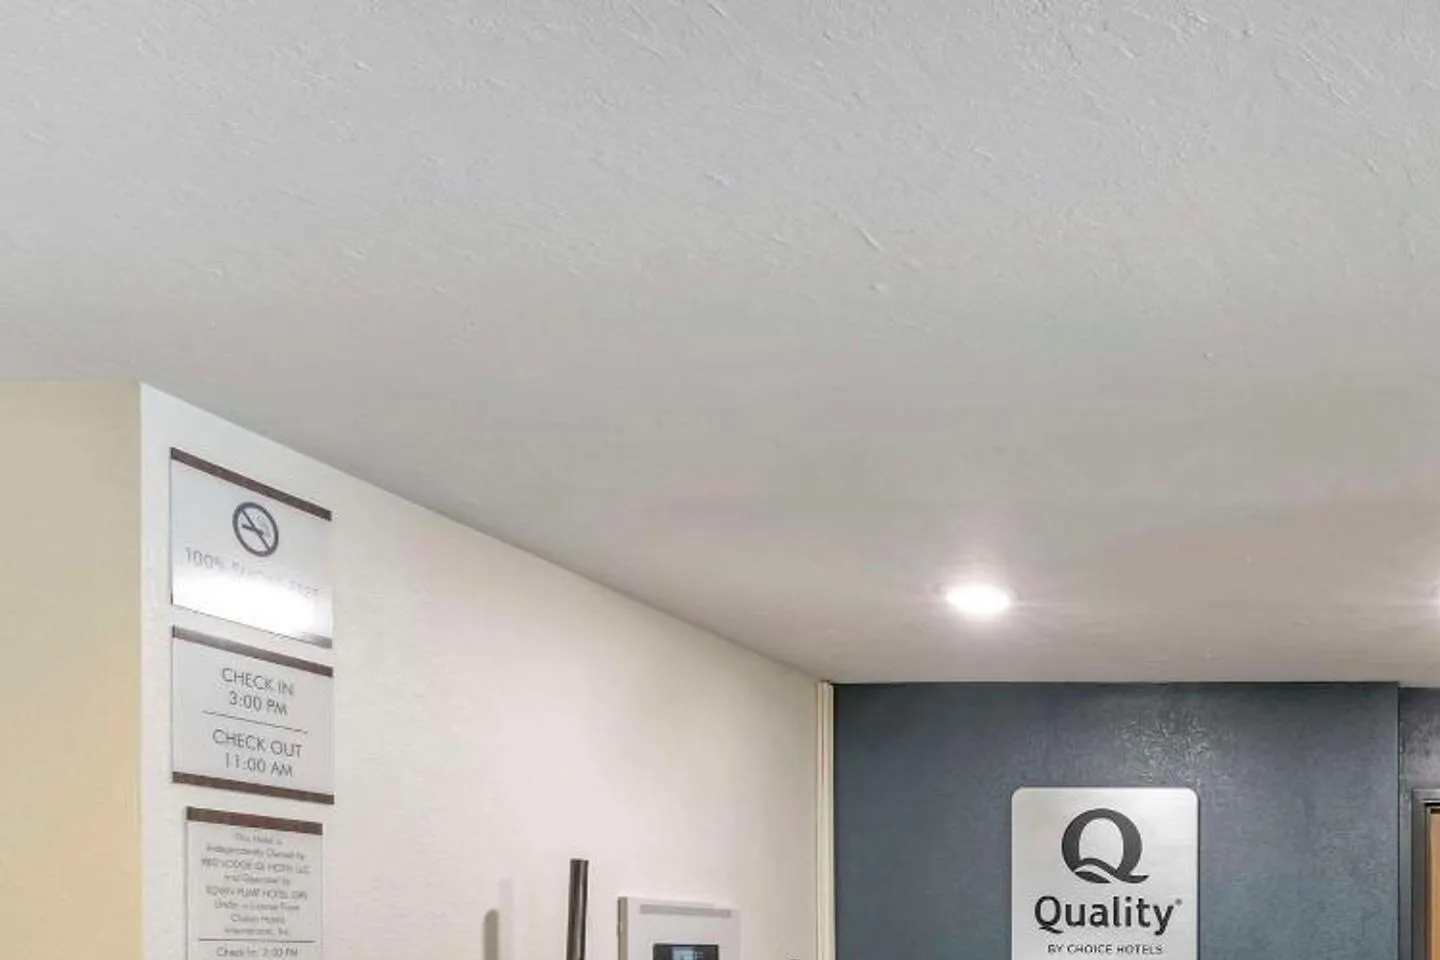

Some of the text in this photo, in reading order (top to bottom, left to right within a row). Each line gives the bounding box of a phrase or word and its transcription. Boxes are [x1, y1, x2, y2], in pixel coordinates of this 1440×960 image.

[221, 667, 294, 696] CHECK IN
[229, 690, 288, 716] 3:00 PM
[212, 728, 302, 758] CHECK OUT
[225, 752, 293, 777] 11:00 AM
[1061, 807, 1150, 884] Q
[1034, 895, 1174, 936] Quality
[1047, 944, 1163, 955] BY CHOICE HOTELS
